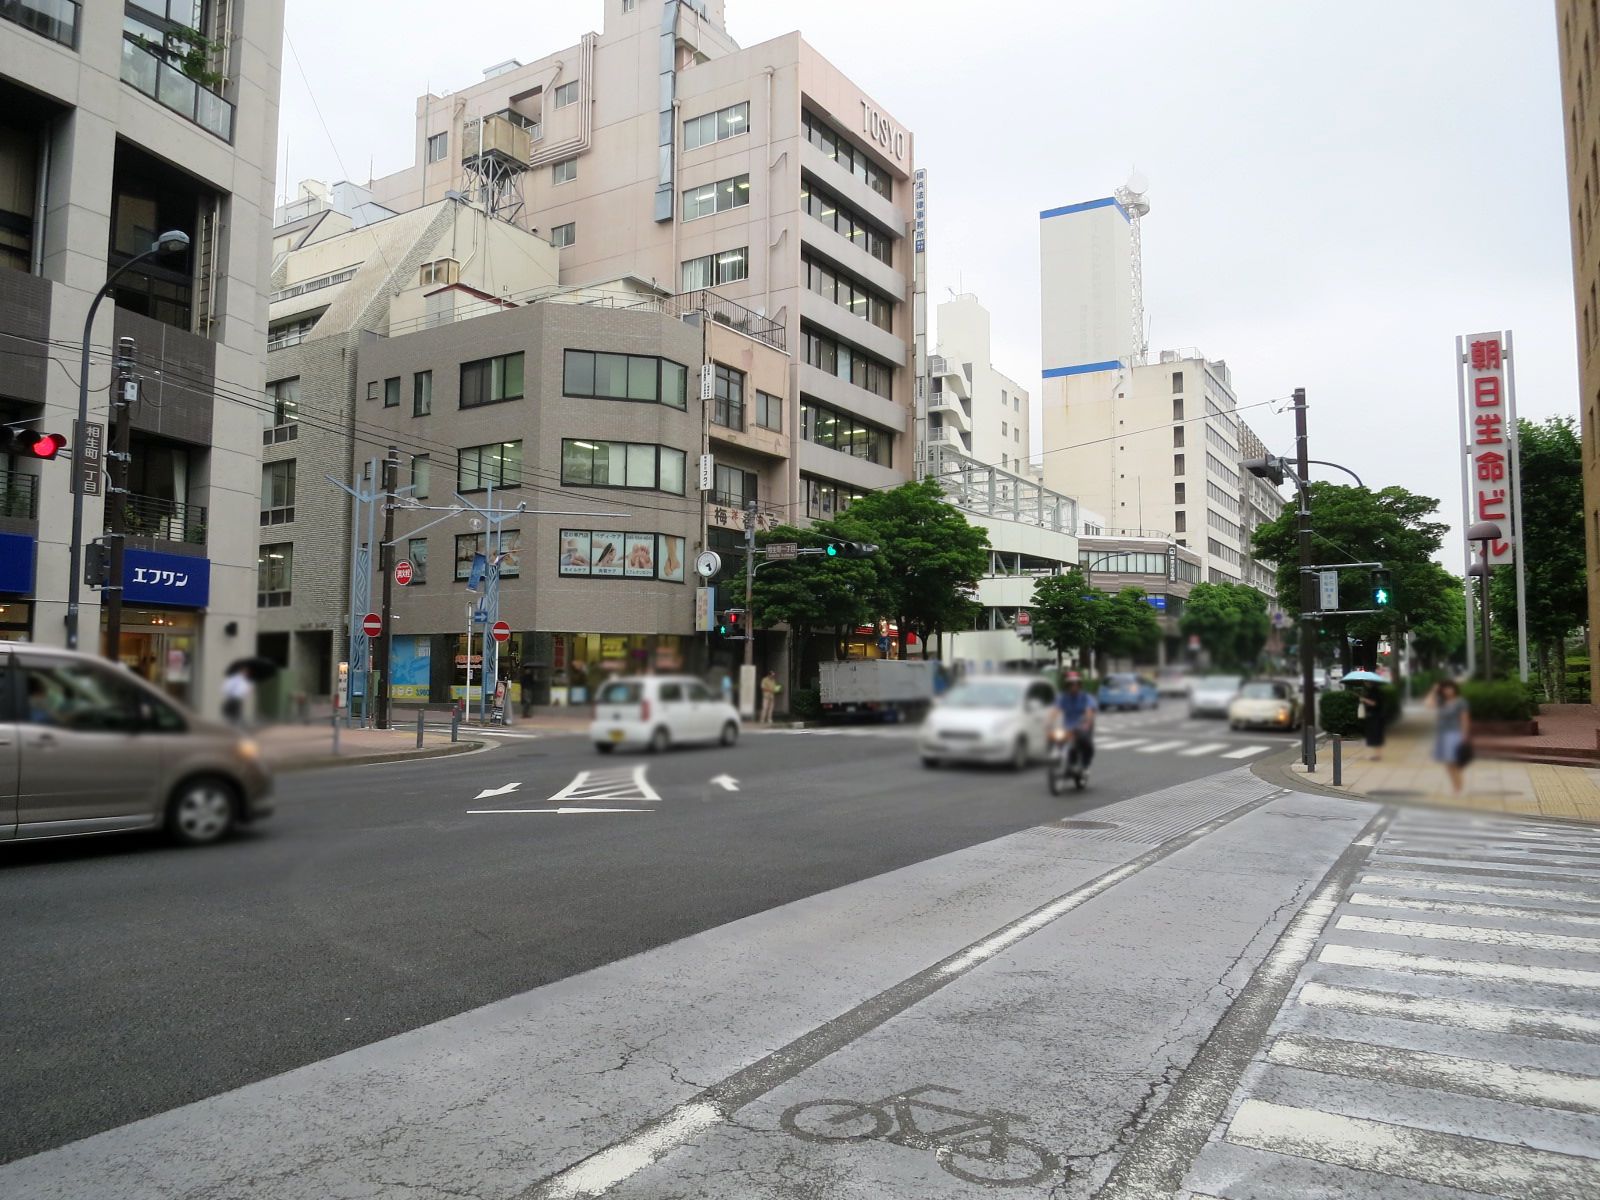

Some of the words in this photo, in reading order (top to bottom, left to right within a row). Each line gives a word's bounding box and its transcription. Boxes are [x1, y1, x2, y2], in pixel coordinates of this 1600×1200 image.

[861, 100, 905, 161] TOSYO
[916, 172, 924, 239] 横浜法律事務所
[84, 426, 99, 493] 相生町一丁目
[133, 567, 188, 587] エフワン
